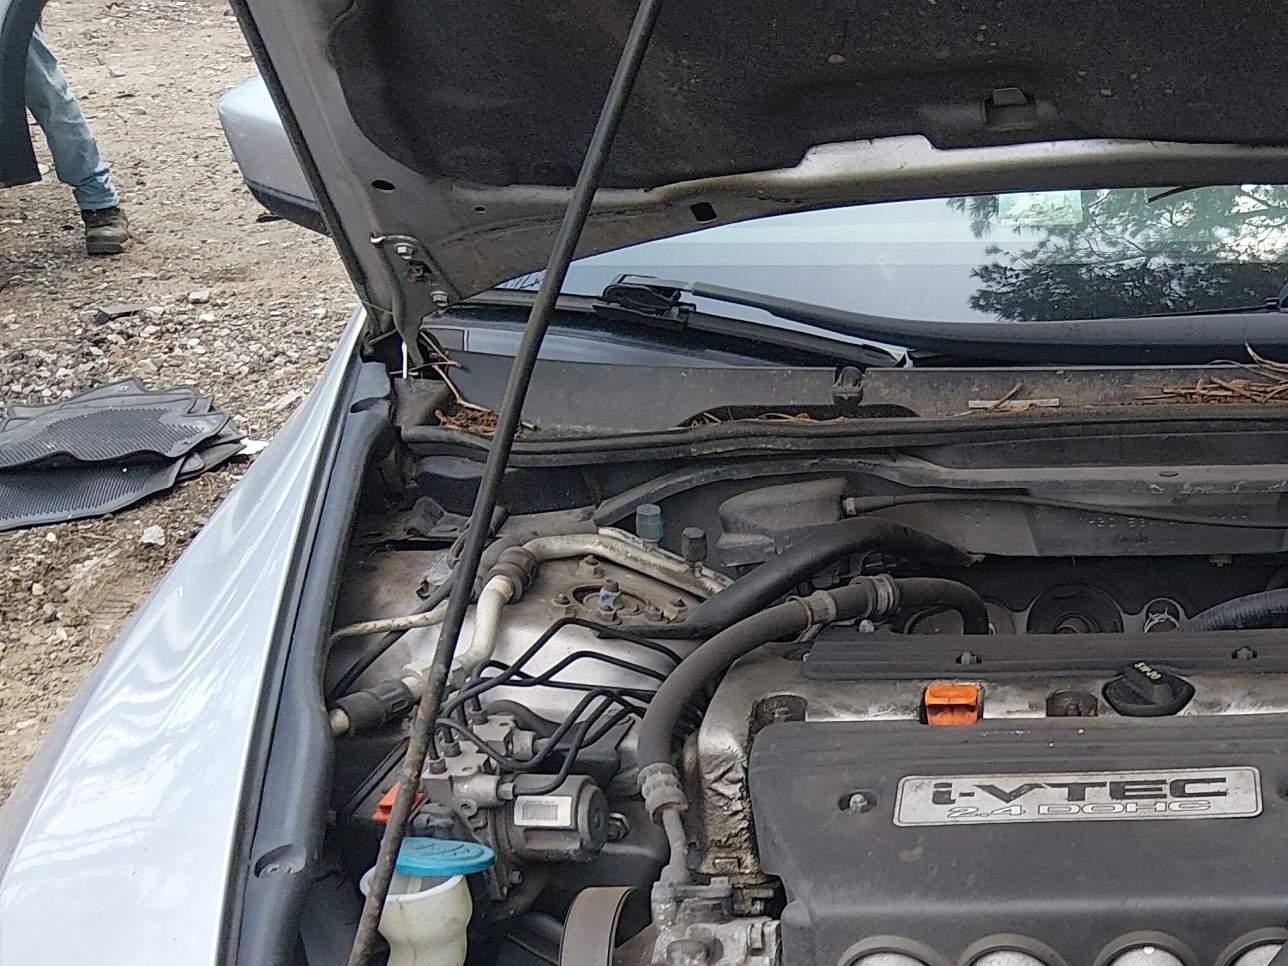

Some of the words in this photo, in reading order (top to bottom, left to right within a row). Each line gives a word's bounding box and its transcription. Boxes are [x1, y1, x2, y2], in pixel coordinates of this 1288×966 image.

[931, 777, 1227, 805] i-VTEC
[946, 803, 1026, 819] 2.4
[1038, 799, 1212, 815] DOHC
